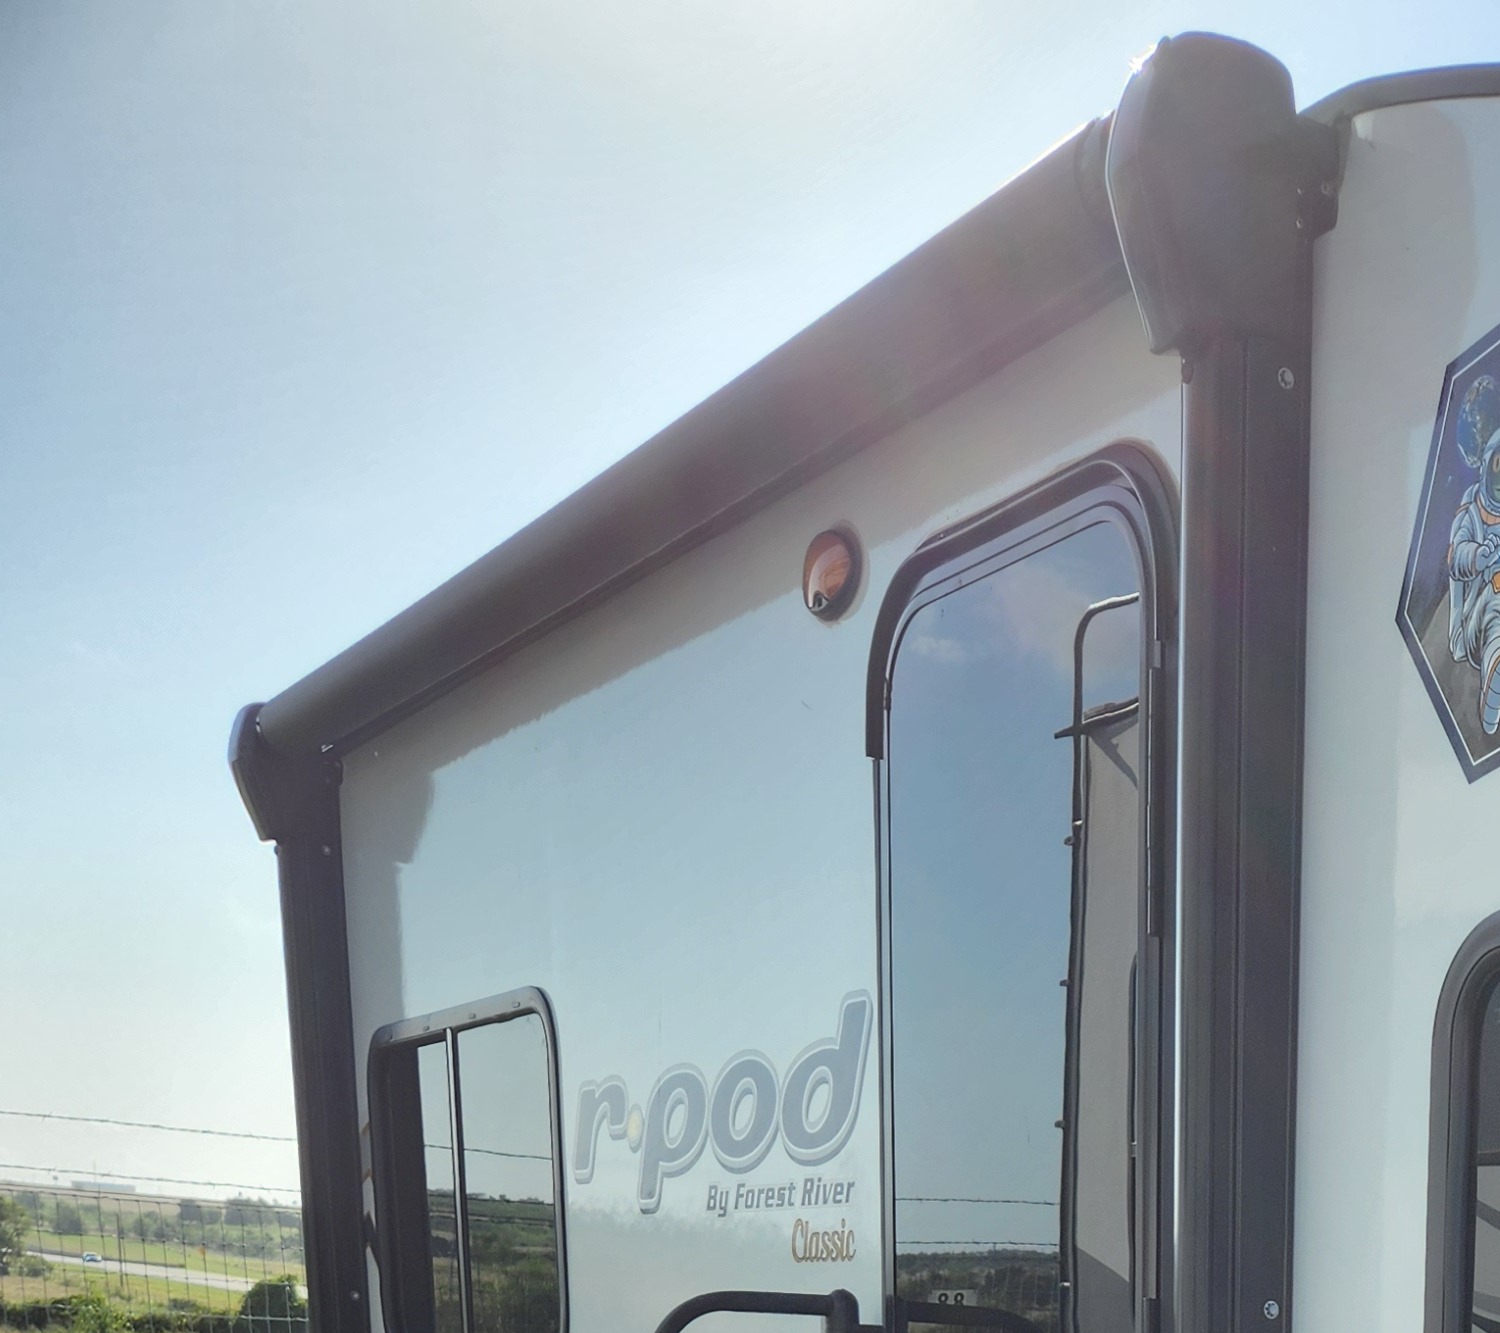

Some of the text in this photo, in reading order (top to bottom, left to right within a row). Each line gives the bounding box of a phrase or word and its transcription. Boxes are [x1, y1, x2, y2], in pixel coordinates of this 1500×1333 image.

[706, 1177, 856, 1217] By Forest River
[791, 1218, 856, 1263] Classic
